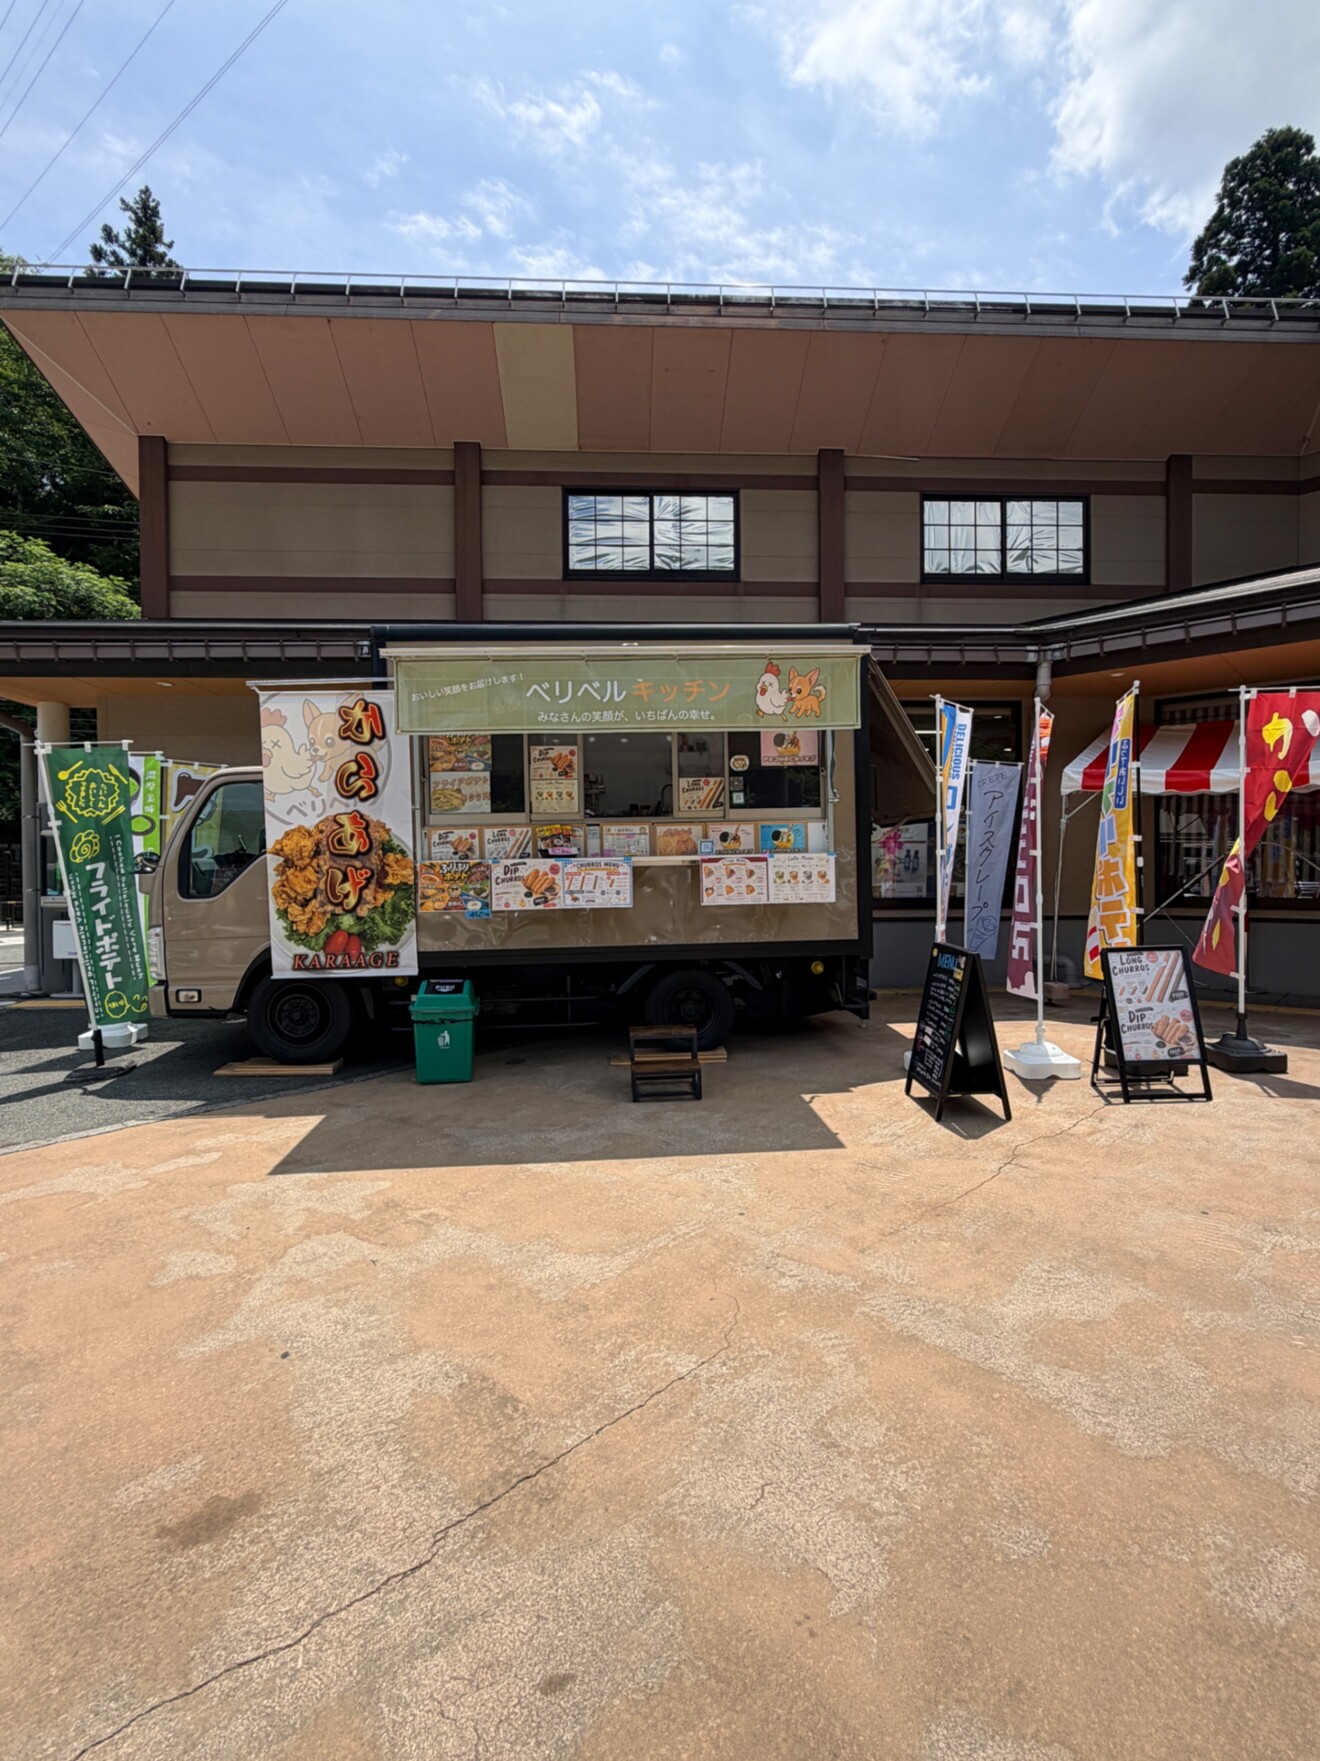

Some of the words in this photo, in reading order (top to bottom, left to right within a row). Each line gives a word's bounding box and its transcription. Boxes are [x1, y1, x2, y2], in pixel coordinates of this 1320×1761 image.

[526, 680, 627, 704] ベリベル
[632, 680, 731, 703] キッチン
[951, 723, 967, 780] DELICIOUS
[976, 771, 1009, 789] CREPE
[325, 698, 386, 911] からあげ
[971, 790, 1005, 921] アイスクレープ
[503, 865, 520, 876] DIP
[85, 862, 123, 990] フライドポテト
[129, 930, 138, 953] Very
[293, 952, 399, 971] KARAAGE
[1119, 954, 1143, 965] LONG
[1112, 964, 1150, 976] CHURROS
[1128, 1011, 1147, 1023] DIP
[1120, 1022, 1154, 1034] CHURROS
